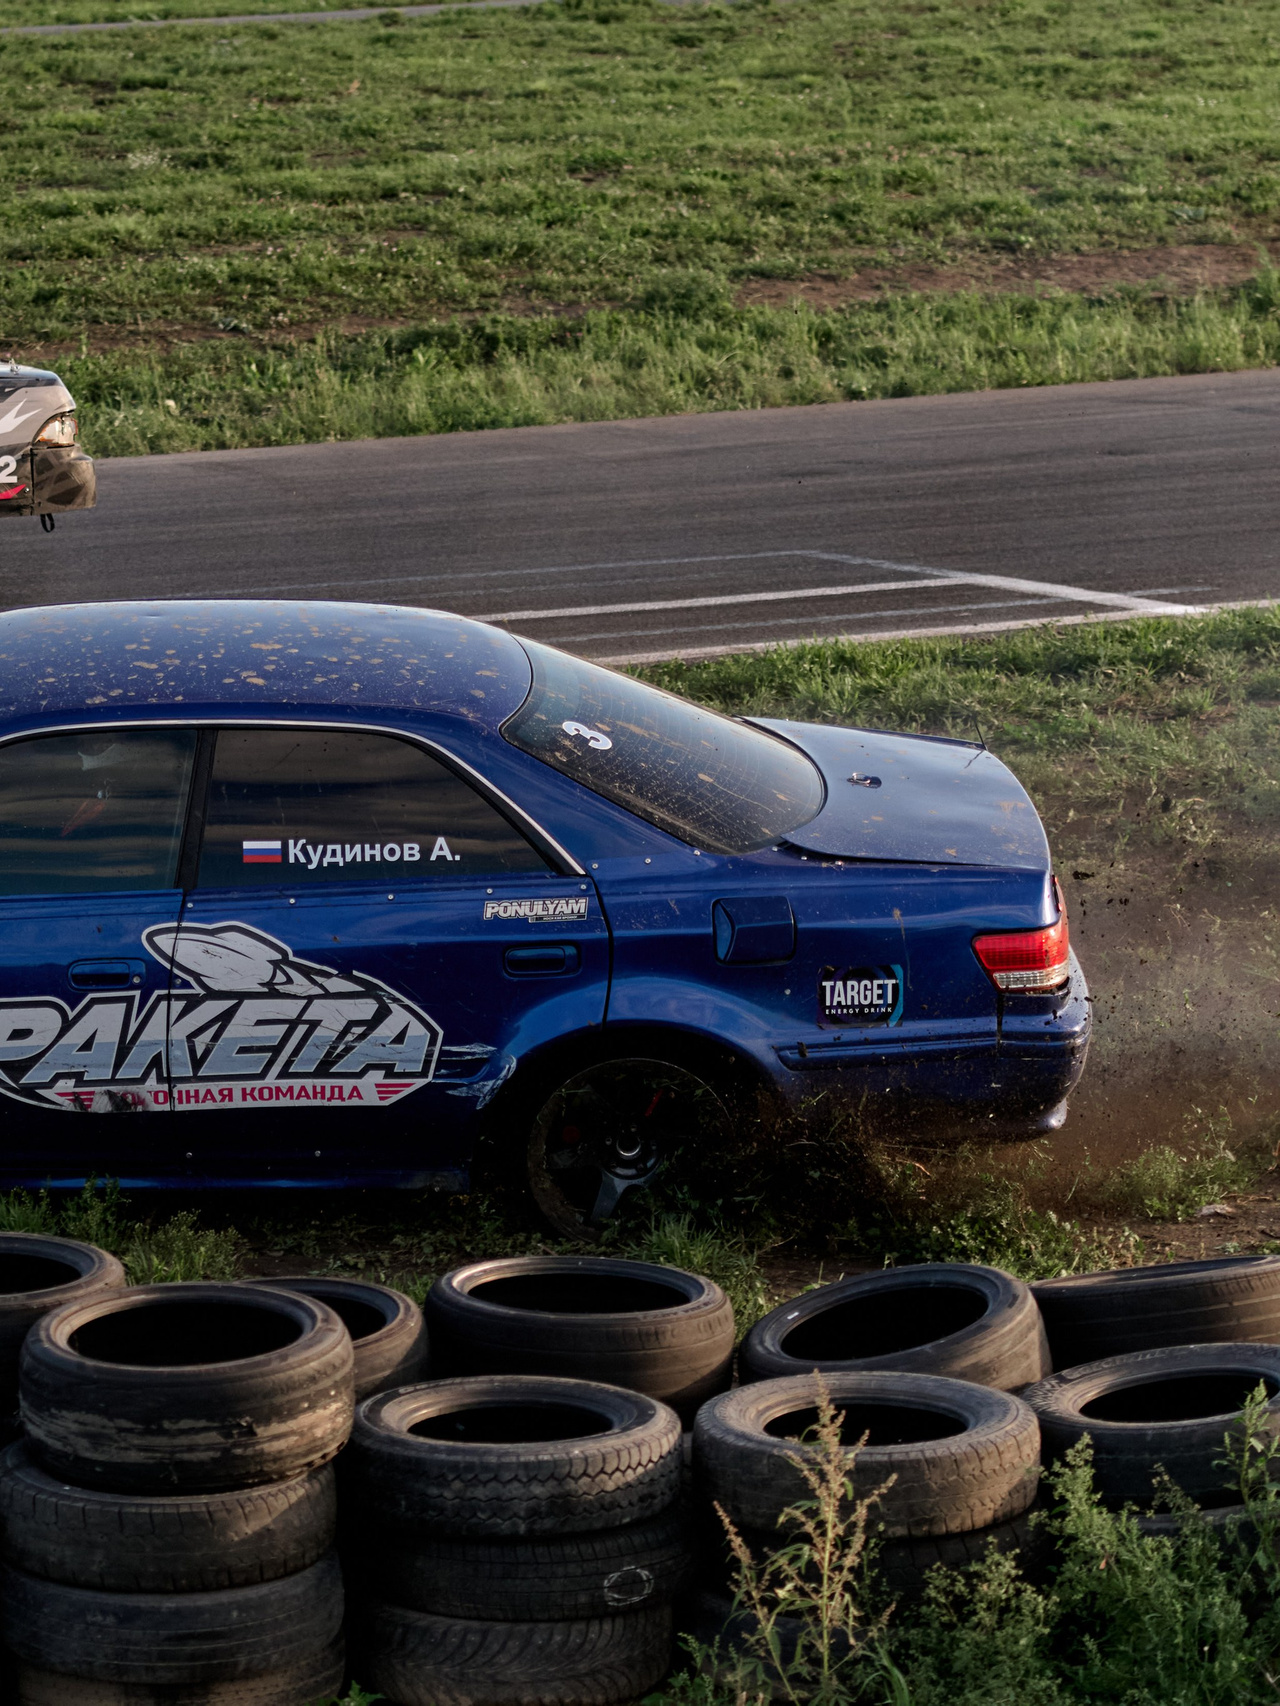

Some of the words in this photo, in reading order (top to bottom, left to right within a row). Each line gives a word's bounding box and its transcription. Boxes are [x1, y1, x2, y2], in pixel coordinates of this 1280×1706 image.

[561, 721, 613, 750] 3
[288, 839, 421, 869] Кудинов
[430, 836, 461, 861] А.
[484, 898, 587, 919] PONULYAM
[822, 979, 896, 1006] TARGET
[241, 1085, 364, 1102] КОМАНДА
